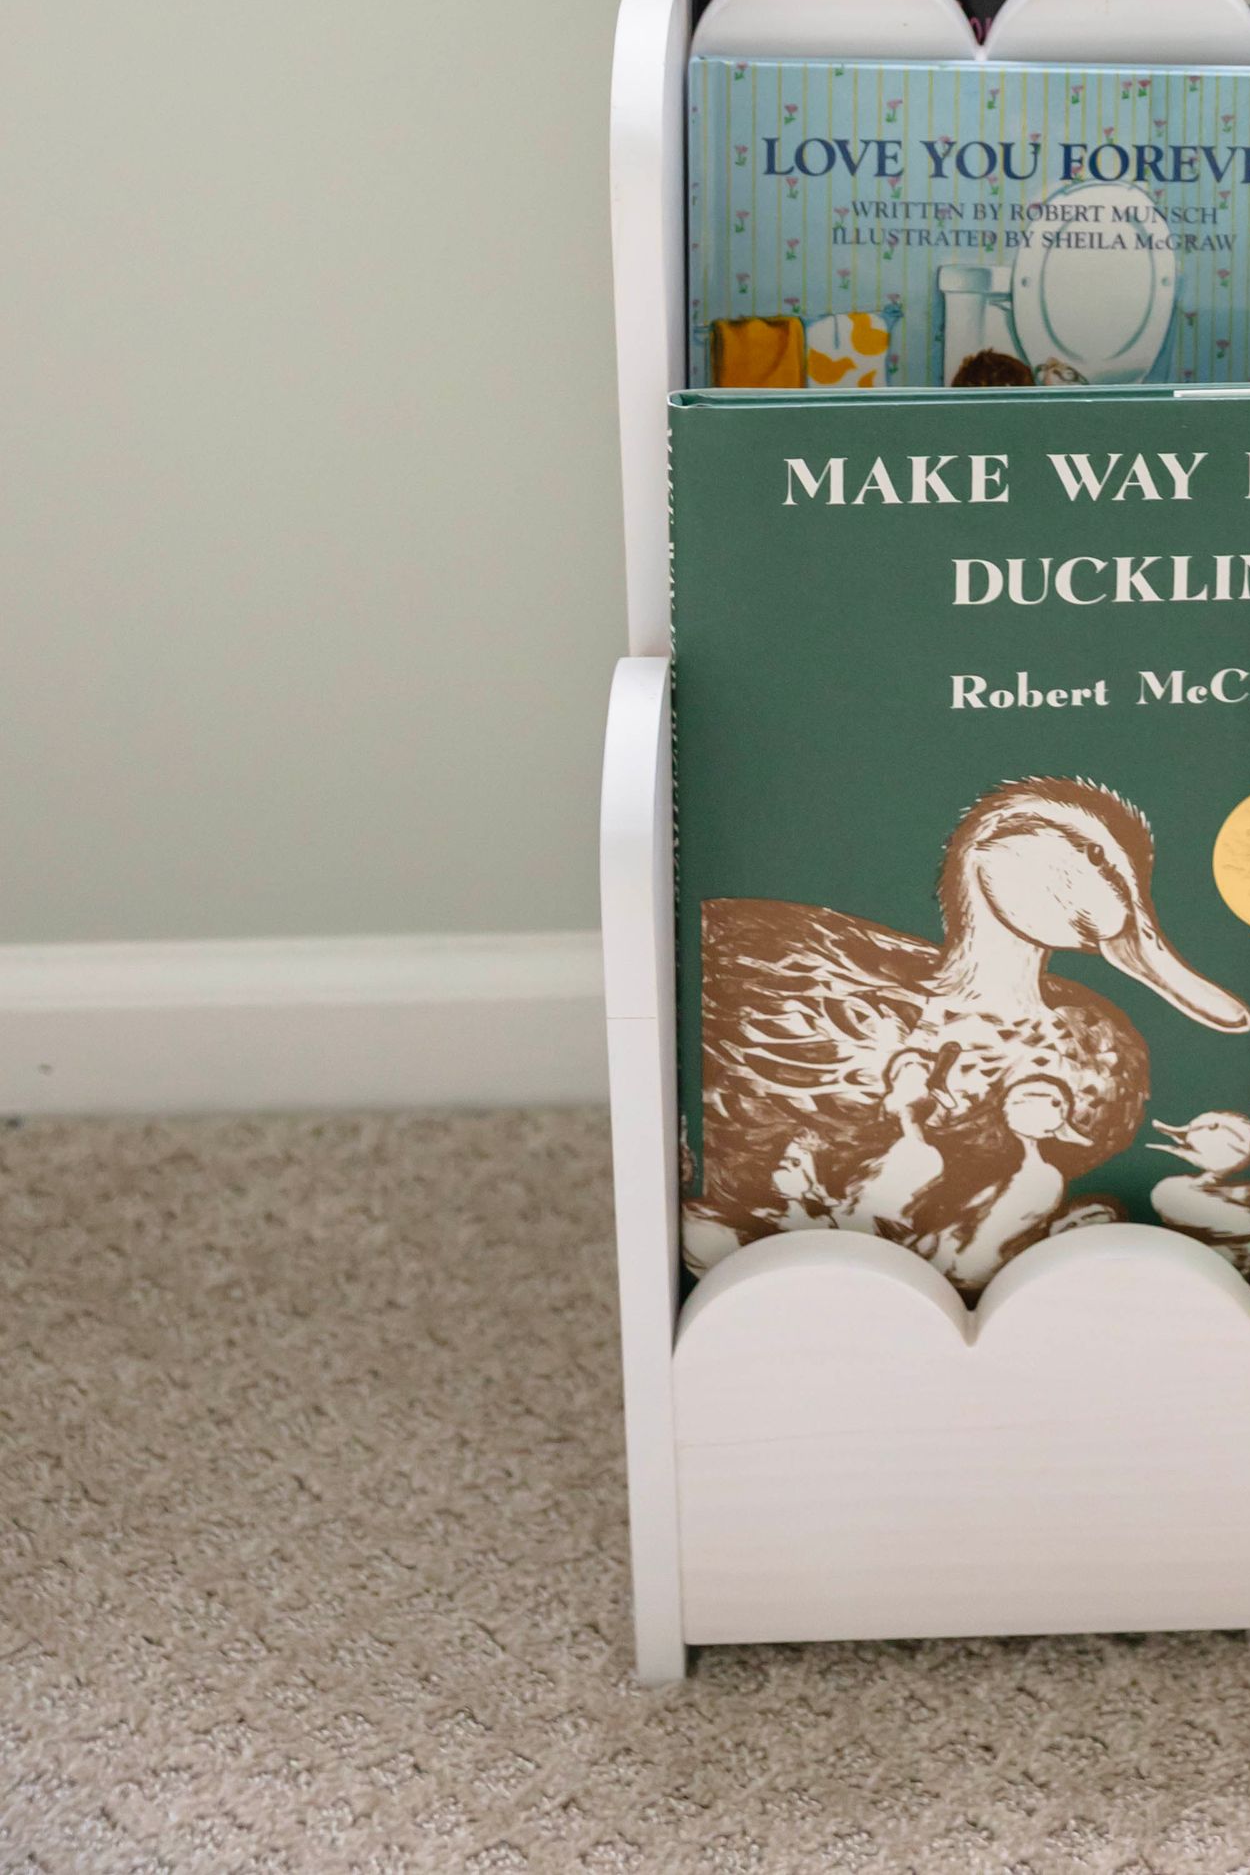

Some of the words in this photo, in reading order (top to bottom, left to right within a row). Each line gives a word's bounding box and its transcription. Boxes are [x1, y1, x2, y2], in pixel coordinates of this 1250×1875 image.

[761, 136, 903, 179] LOVE
[920, 138, 1041, 181] YOU
[850, 200, 966, 221] WRITTEN
[972, 202, 1005, 222] BY
[1009, 203, 1106, 224] ROBERT
[1110, 204, 1219, 226] MUNSCH
[831, 226, 1000, 249] ILLUSTRATED
[1004, 229, 1036, 249] BY
[1041, 230, 1129, 251] SHEILA
[1133, 232, 1238, 253] McGRAW
[782, 453, 1010, 506] MAKE
[1046, 451, 1208, 503] WAY
[950, 671, 1110, 710] Robert
